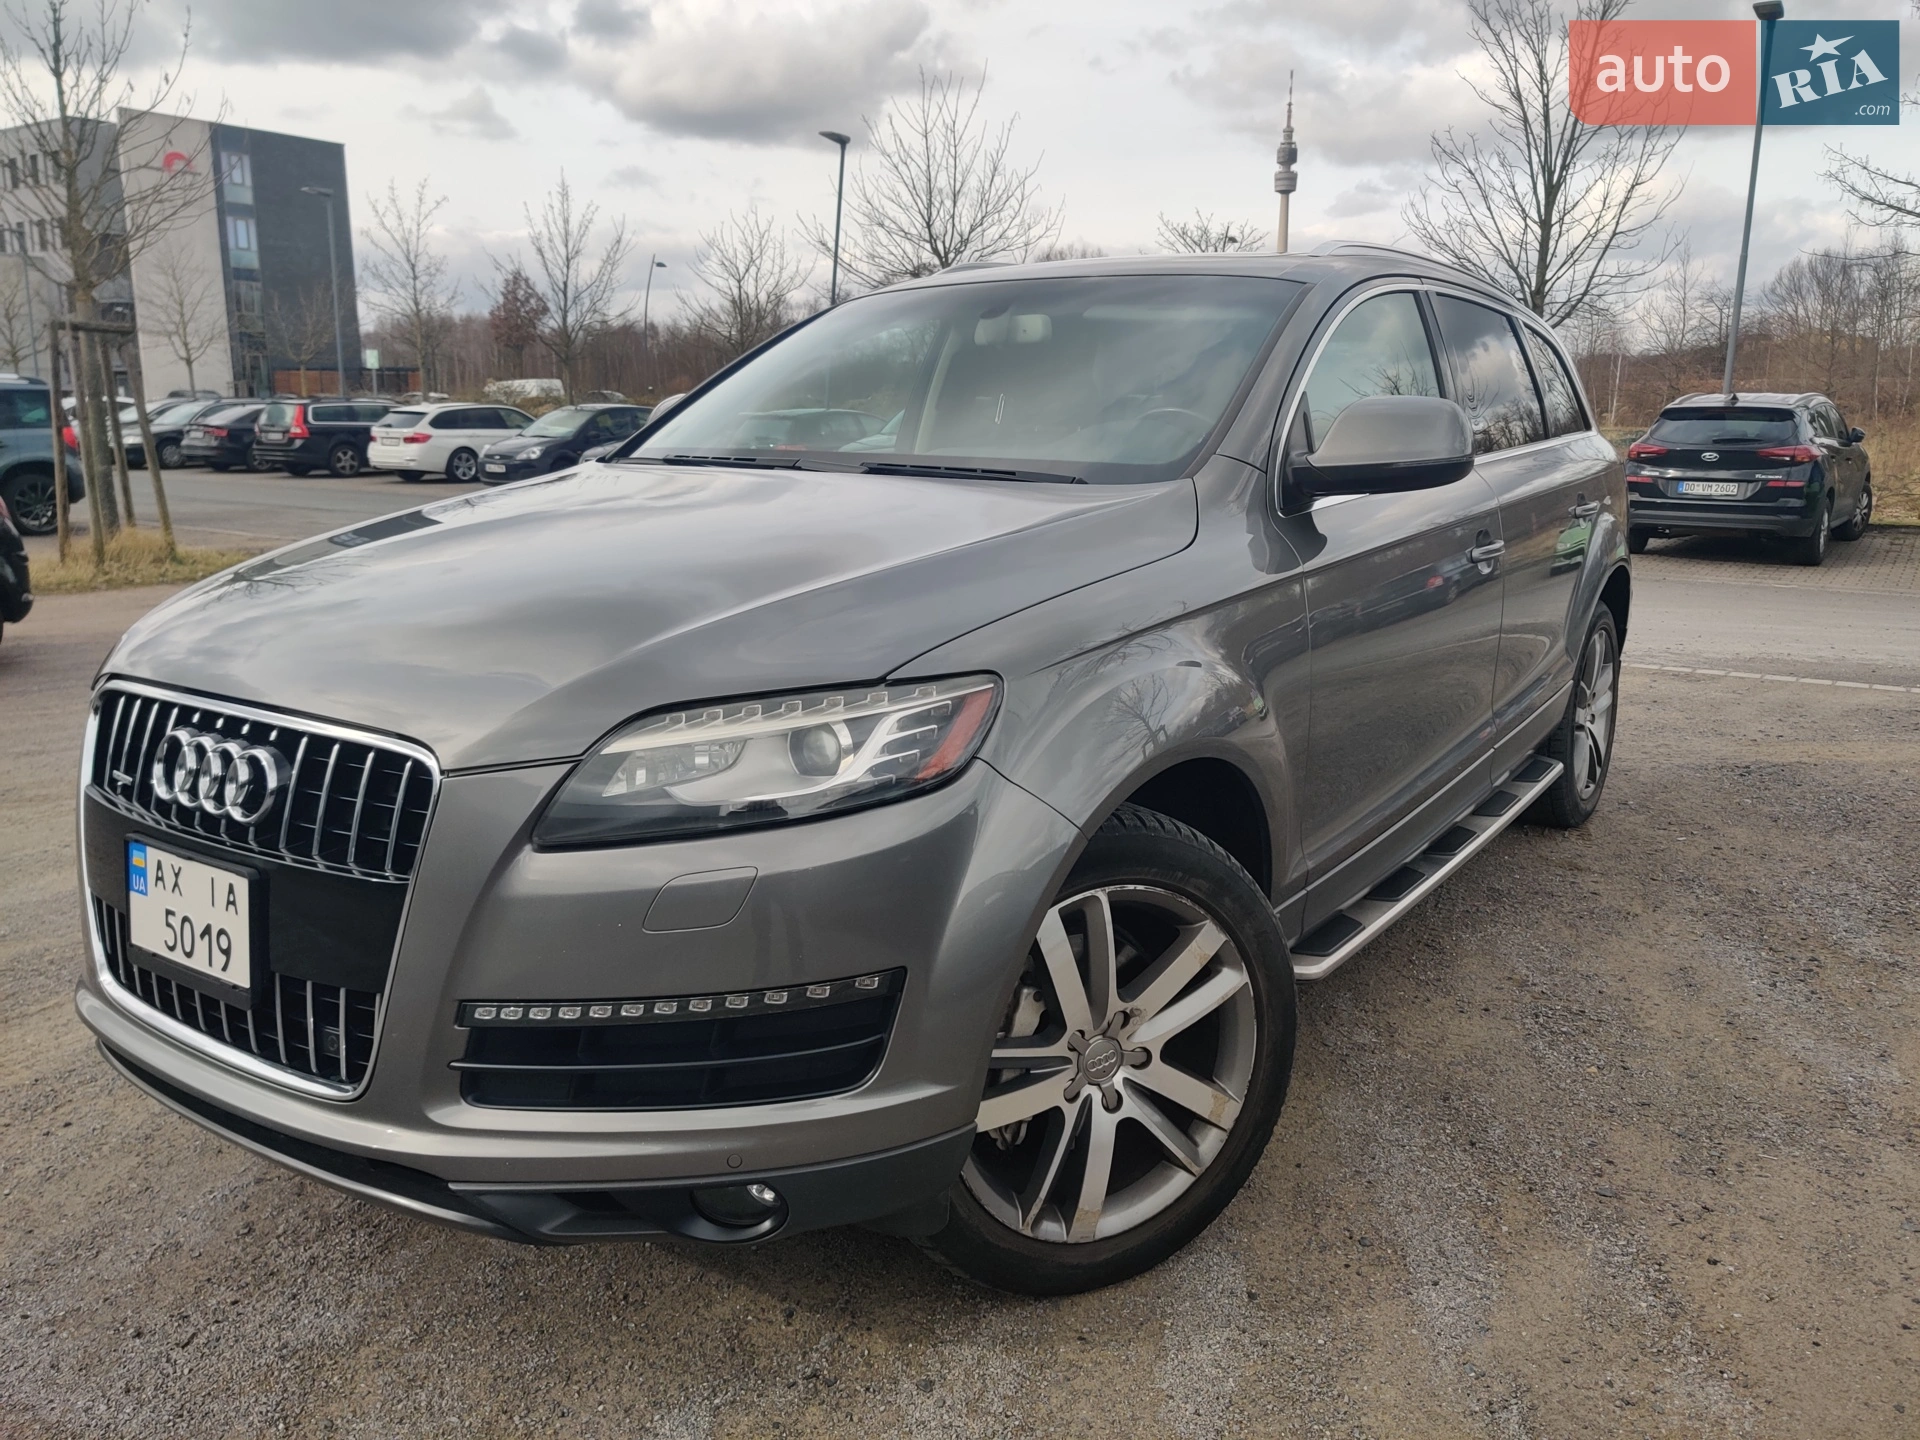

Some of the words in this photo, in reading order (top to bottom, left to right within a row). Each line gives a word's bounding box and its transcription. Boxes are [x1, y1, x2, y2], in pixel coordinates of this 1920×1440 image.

[1714, 484, 1737, 493] 2602
[133, 873, 146, 893] UA
[155, 859, 182, 897] AX
[211, 876, 238, 915] IA
[164, 908, 232, 972] 5019
